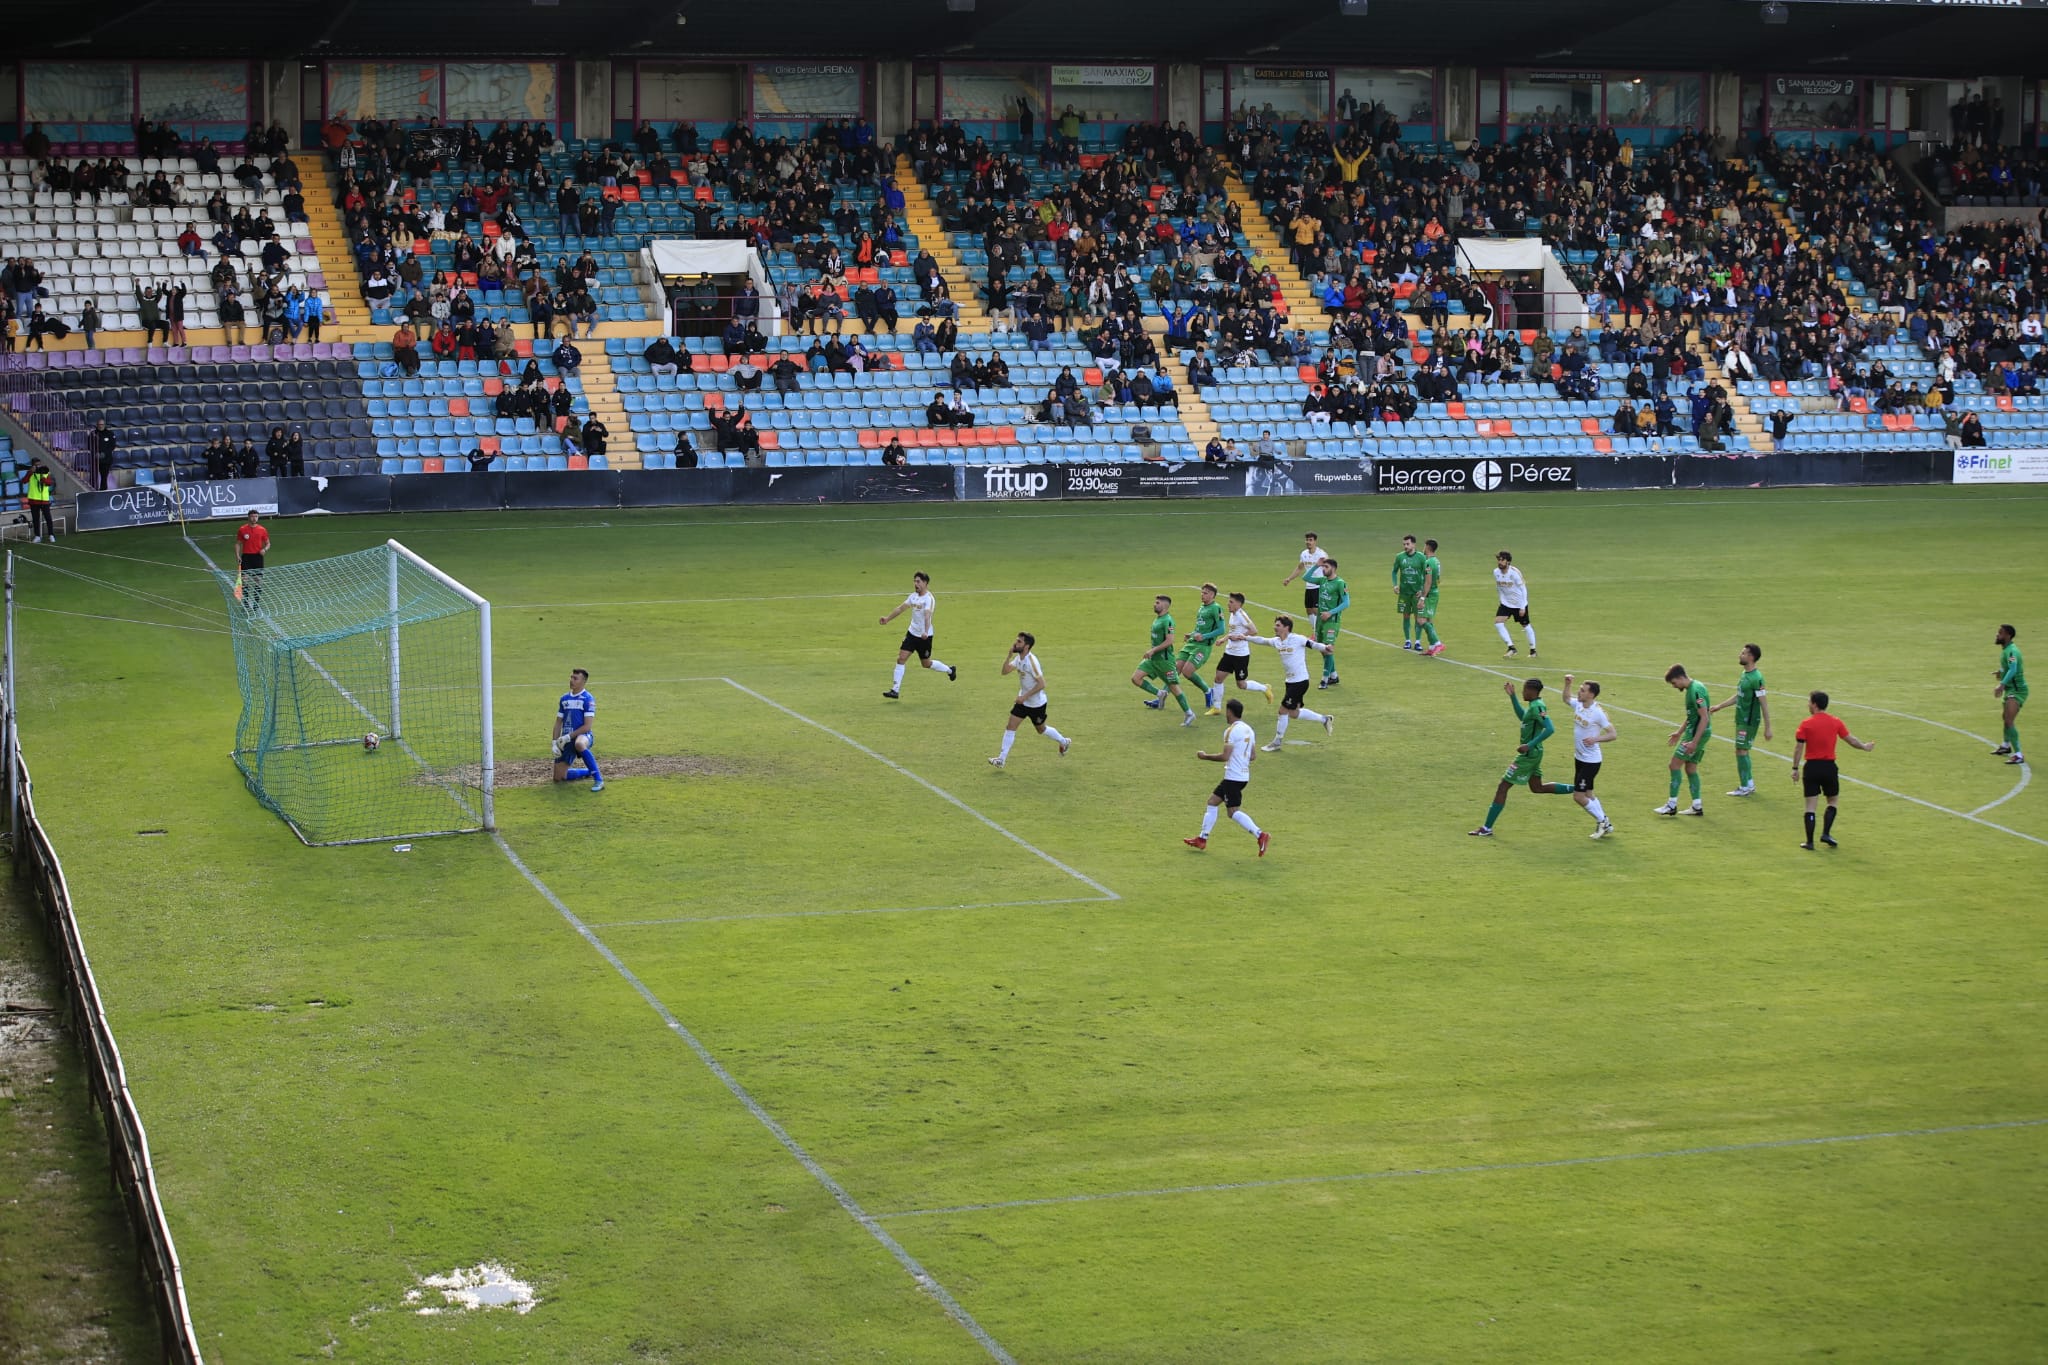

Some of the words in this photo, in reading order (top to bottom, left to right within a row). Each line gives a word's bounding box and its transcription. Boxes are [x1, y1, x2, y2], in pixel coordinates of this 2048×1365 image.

[1970, 454, 2012, 469] Frinet
[1068, 468, 1080, 477] TU
[1081, 468, 1122, 477] GIMNASIO
[1314, 473, 1363, 483] fitupweb.es
[1379, 466, 1465, 484] Herrero
[1510, 464, 1572, 482] Pérez
[984, 466, 1048, 496] fitup
